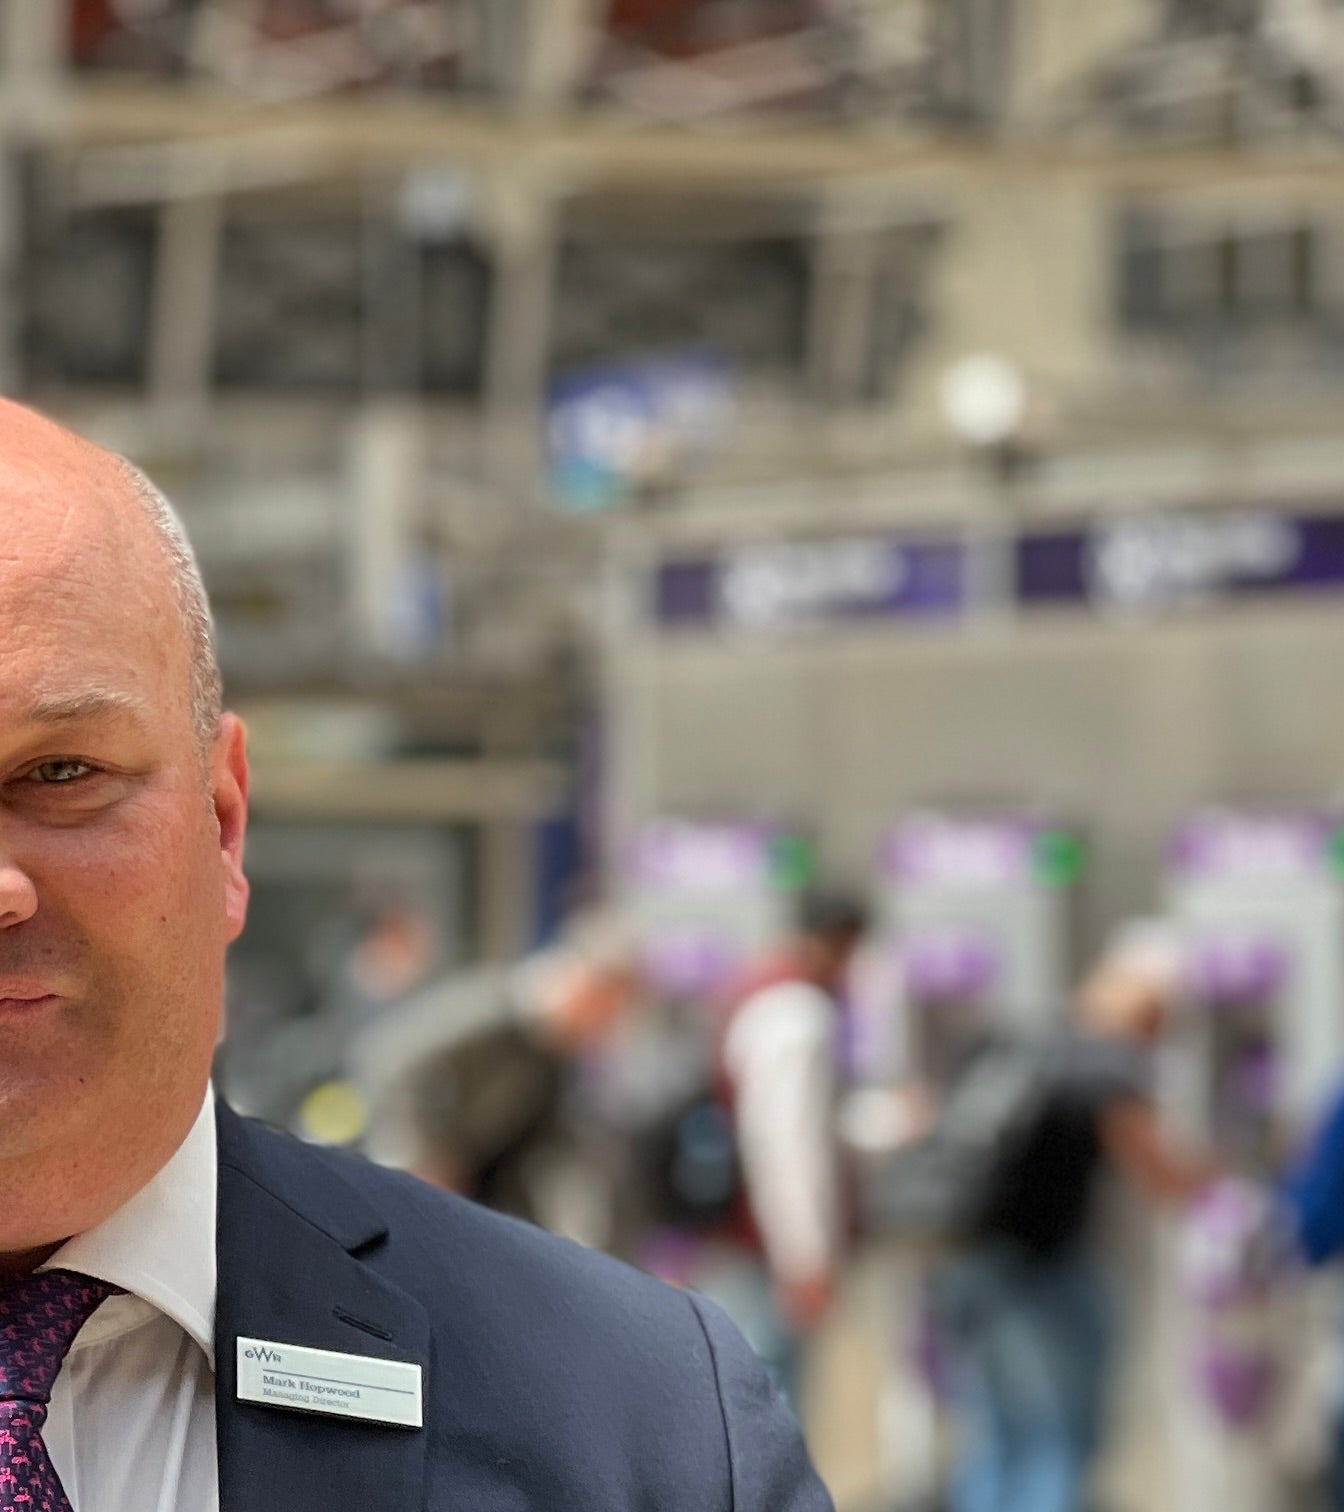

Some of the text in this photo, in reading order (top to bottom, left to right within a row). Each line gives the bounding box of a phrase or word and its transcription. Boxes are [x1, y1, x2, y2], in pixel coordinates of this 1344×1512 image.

[244, 1346, 282, 1362] GWR
[263, 1375, 361, 1398] Mark Hopwood
[263, 1388, 349, 1409] Managing Director
